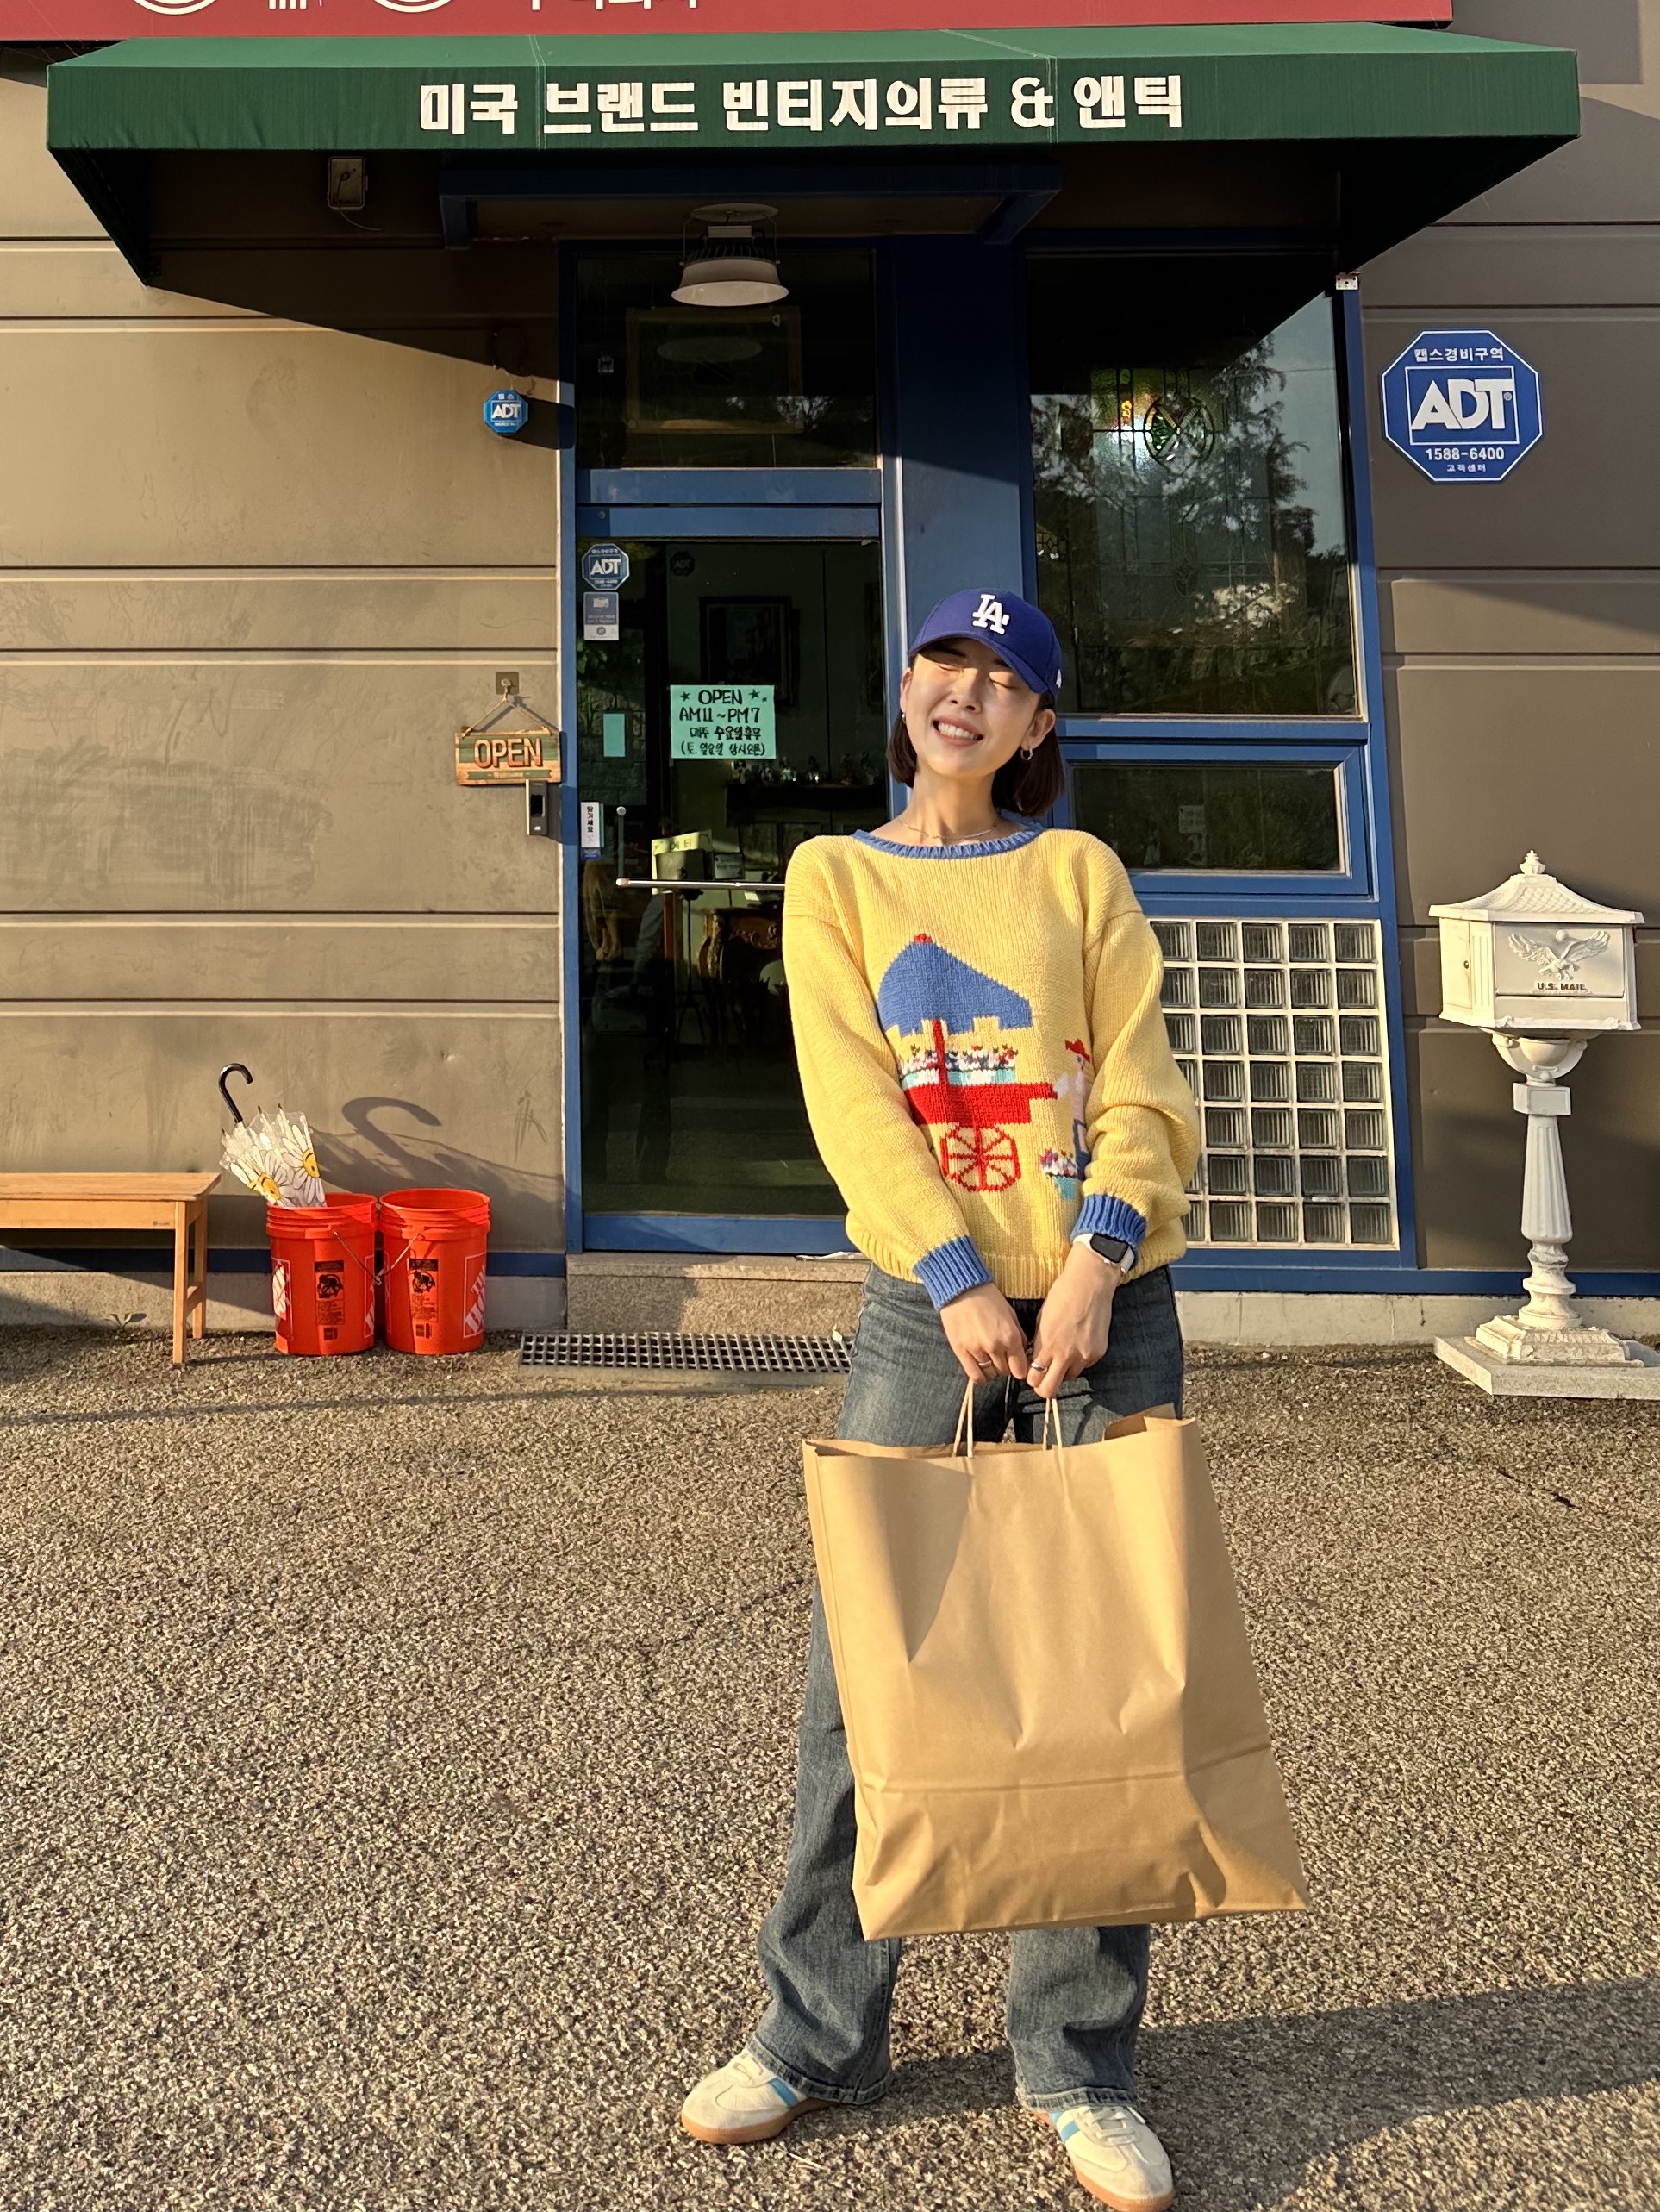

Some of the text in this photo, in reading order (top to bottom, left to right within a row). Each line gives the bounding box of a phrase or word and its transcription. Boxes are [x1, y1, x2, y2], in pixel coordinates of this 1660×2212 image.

[420, 74, 1183, 134] 미국 브랜드 빈티지의류 & 앤틱
[1413, 347, 1504, 363] 캡스경비구역
[491, 403, 521, 419] ADT
[1411, 378, 1514, 430] ADT
[1425, 447, 1505, 461] 1588-6400
[590, 559, 621, 576] ADT
[971, 593, 1010, 634] LA
[697, 689, 743, 705] OPEN
[474, 738, 543, 768] OPEN
[1537, 982, 1587, 991] U.S. MAIL
